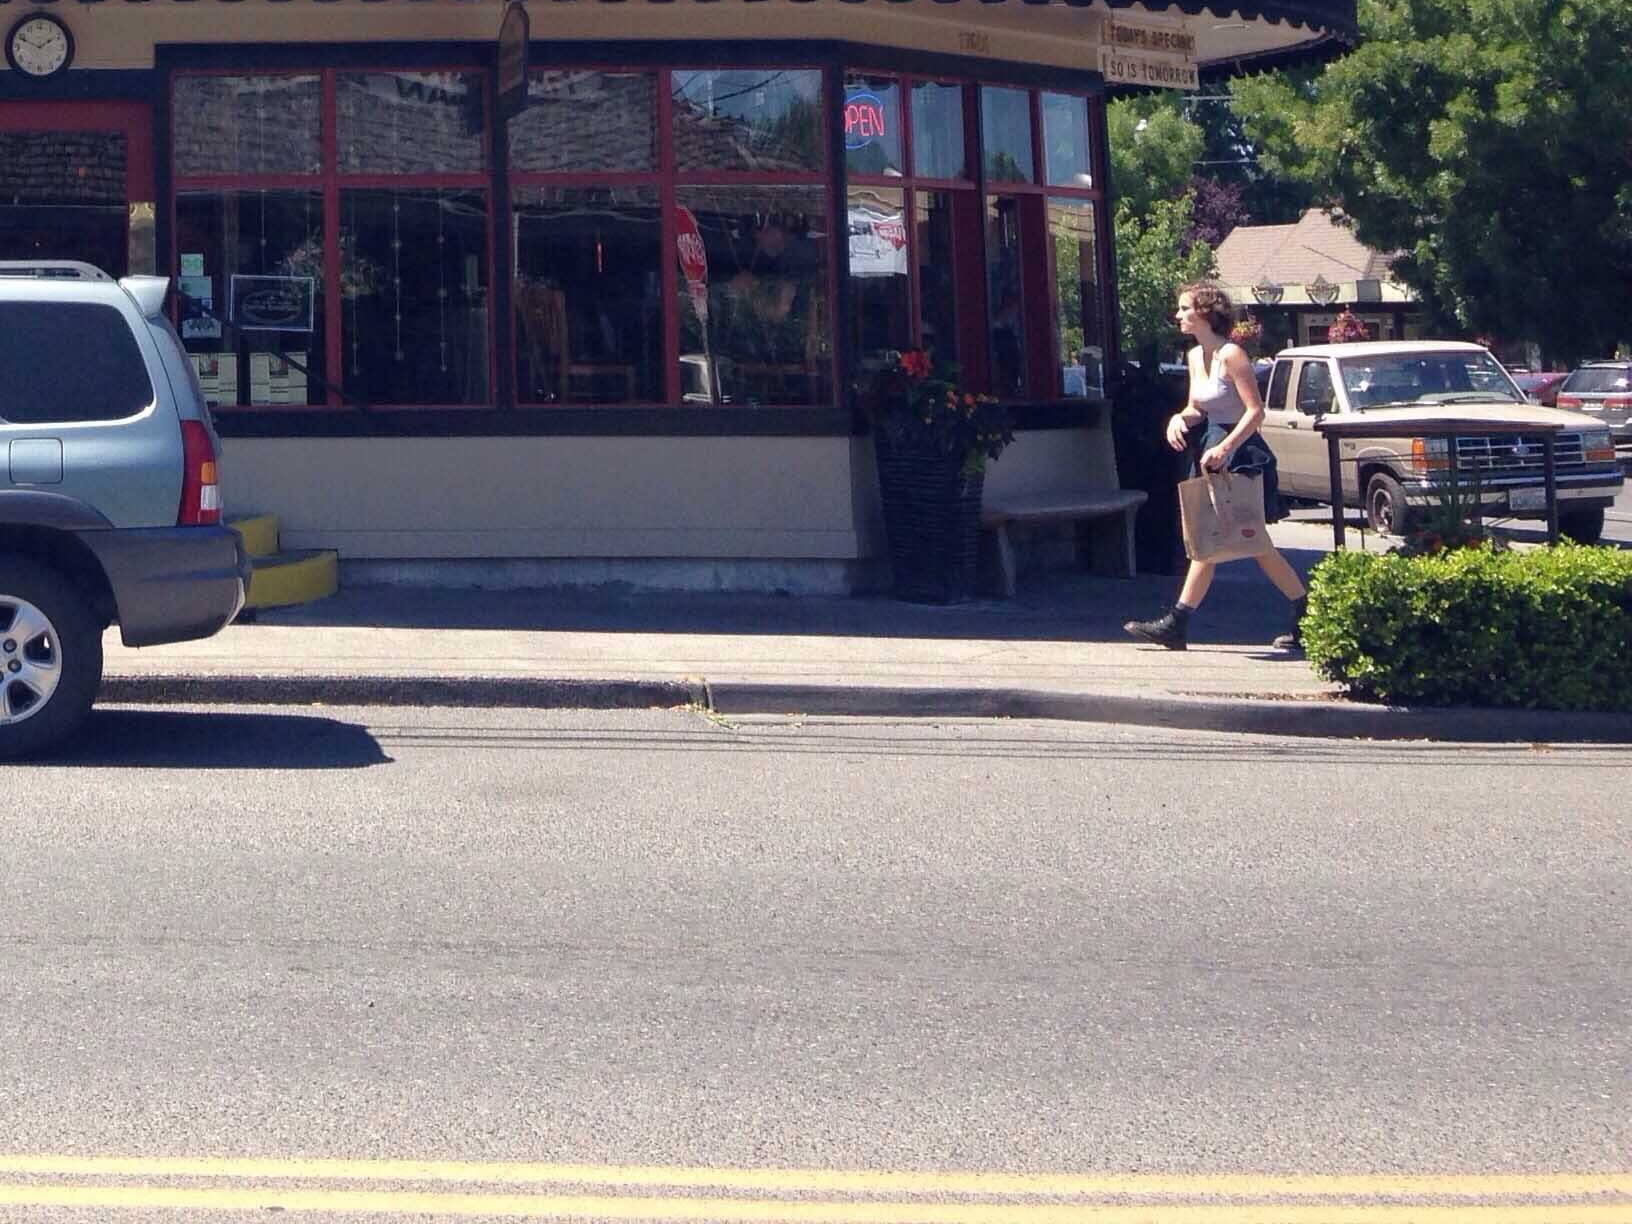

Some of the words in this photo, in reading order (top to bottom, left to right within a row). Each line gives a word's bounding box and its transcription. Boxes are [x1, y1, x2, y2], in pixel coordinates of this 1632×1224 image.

[1110, 60, 1124, 77] SO
[1127, 62, 1137, 78] IS
[1141, 62, 1196, 84] TOMORROW
